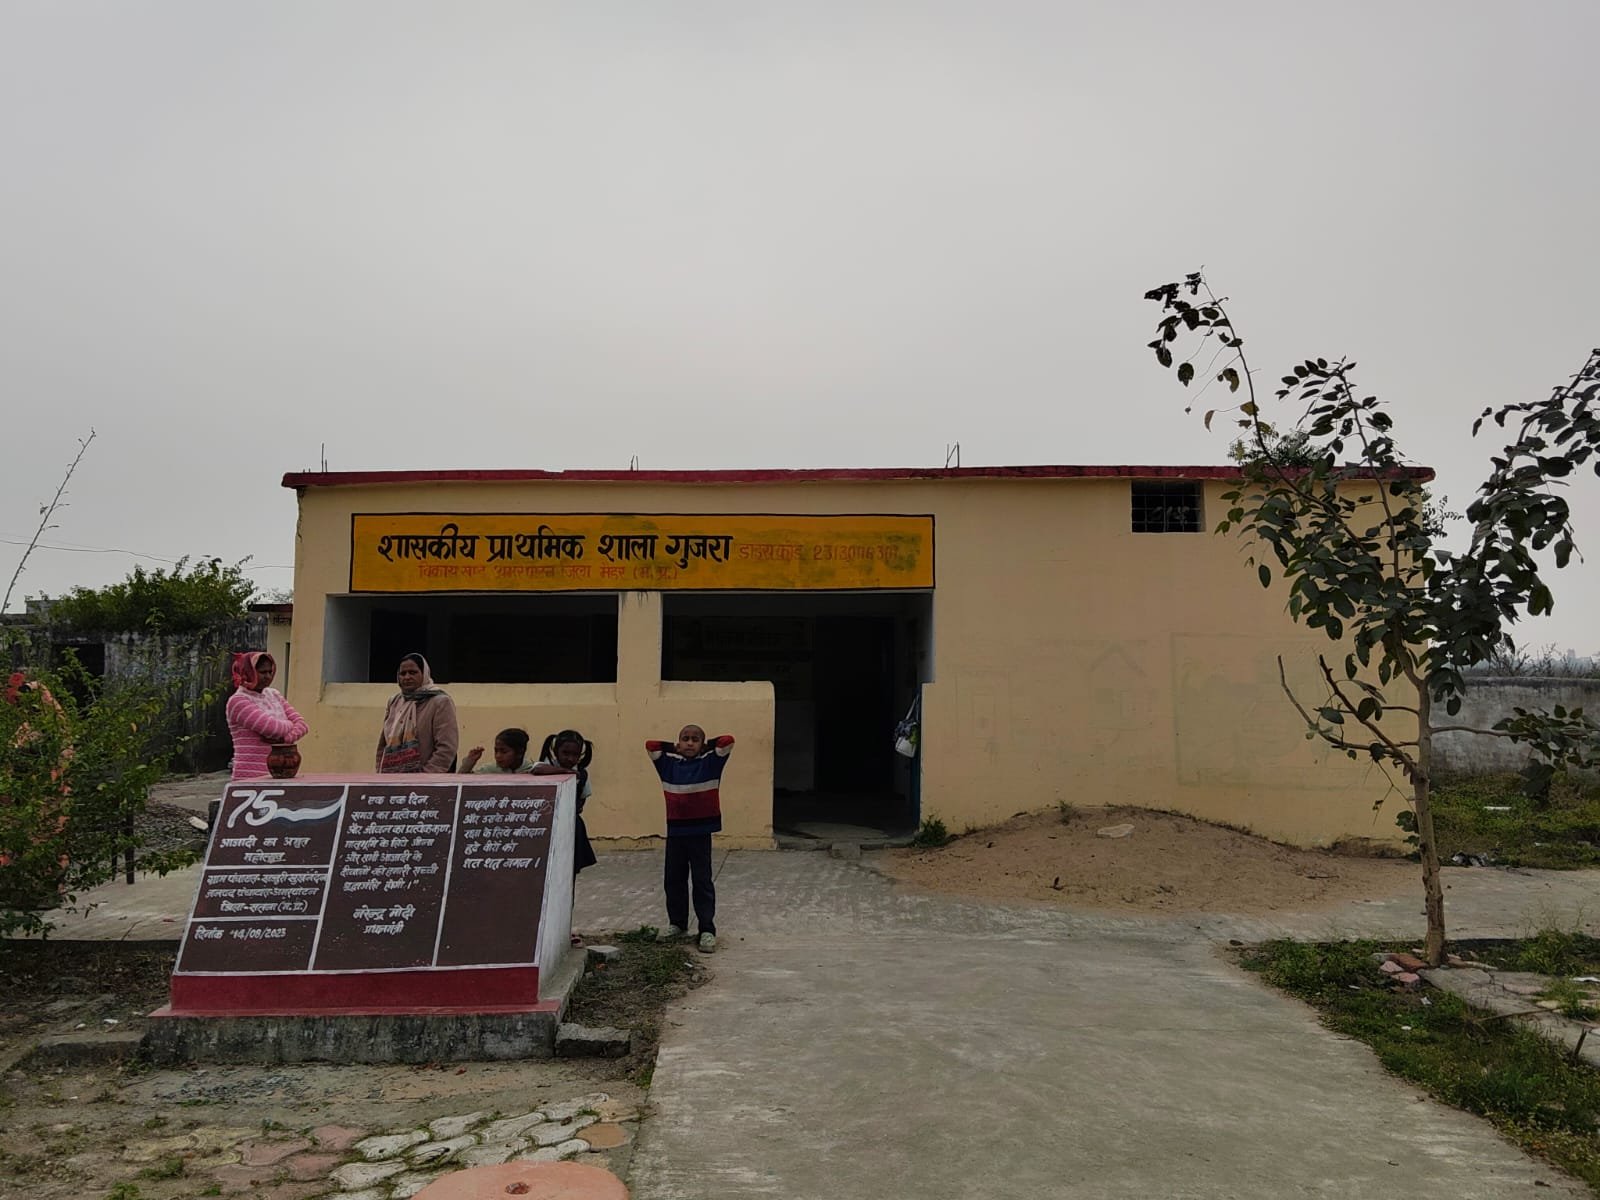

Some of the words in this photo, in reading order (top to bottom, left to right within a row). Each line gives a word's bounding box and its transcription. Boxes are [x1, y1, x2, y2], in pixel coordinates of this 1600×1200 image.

[378, 523, 479, 562] शासकीय
[485, 524, 585, 562] प्राथमिक
[598, 534, 658, 562] शाला
[665, 535, 733, 569] गुजरा
[389, 795, 407, 805] एक
[464, 797, 498, 811] मातृभूमि
[498, 797, 511, 808] की
[227, 789, 286, 828] 75
[351, 811, 374, 821] समय
[376, 811, 391, 820] का
[390, 808, 419, 820] प्रत्येक
[463, 813, 480, 824] और
[482, 812, 504, 824] उसके
[504, 812, 527, 822] गौरव
[529, 810, 541, 823] की
[347, 822, 363, 834] और
[363, 822, 393, 834] जीवन
[392, 824, 406, 834] का
[464, 829, 482, 839] रक्षा
[482, 827, 493, 837] के
[513, 826, 547, 838] बलिदान
[220, 835, 258, 848] आजादी
[263, 837, 278, 847] का
[283, 836, 311, 848] अमृत
[344, 837, 380, 850] मातृभूमि
[379, 837, 389, 848] के
[411, 836, 435, 847] जीना
[482, 840, 502, 852] वीरों
[502, 839, 519, 853] को
[345, 851, 361, 864] और
[361, 850, 380, 863] सभी
[412, 850, 422, 862] के
[463, 858, 484, 869] शत
[483, 857, 504, 870] शत
[371, 865, 387, 876] को
[386, 864, 411, 877] हमारी
[412, 863, 439, 876] सच्ची
[205, 888, 235, 898] जनपद
[353, 904, 387, 920] नरेन्द्र
[389, 904, 416, 920] मोदी
[194, 925, 224, 940] दिनांक
